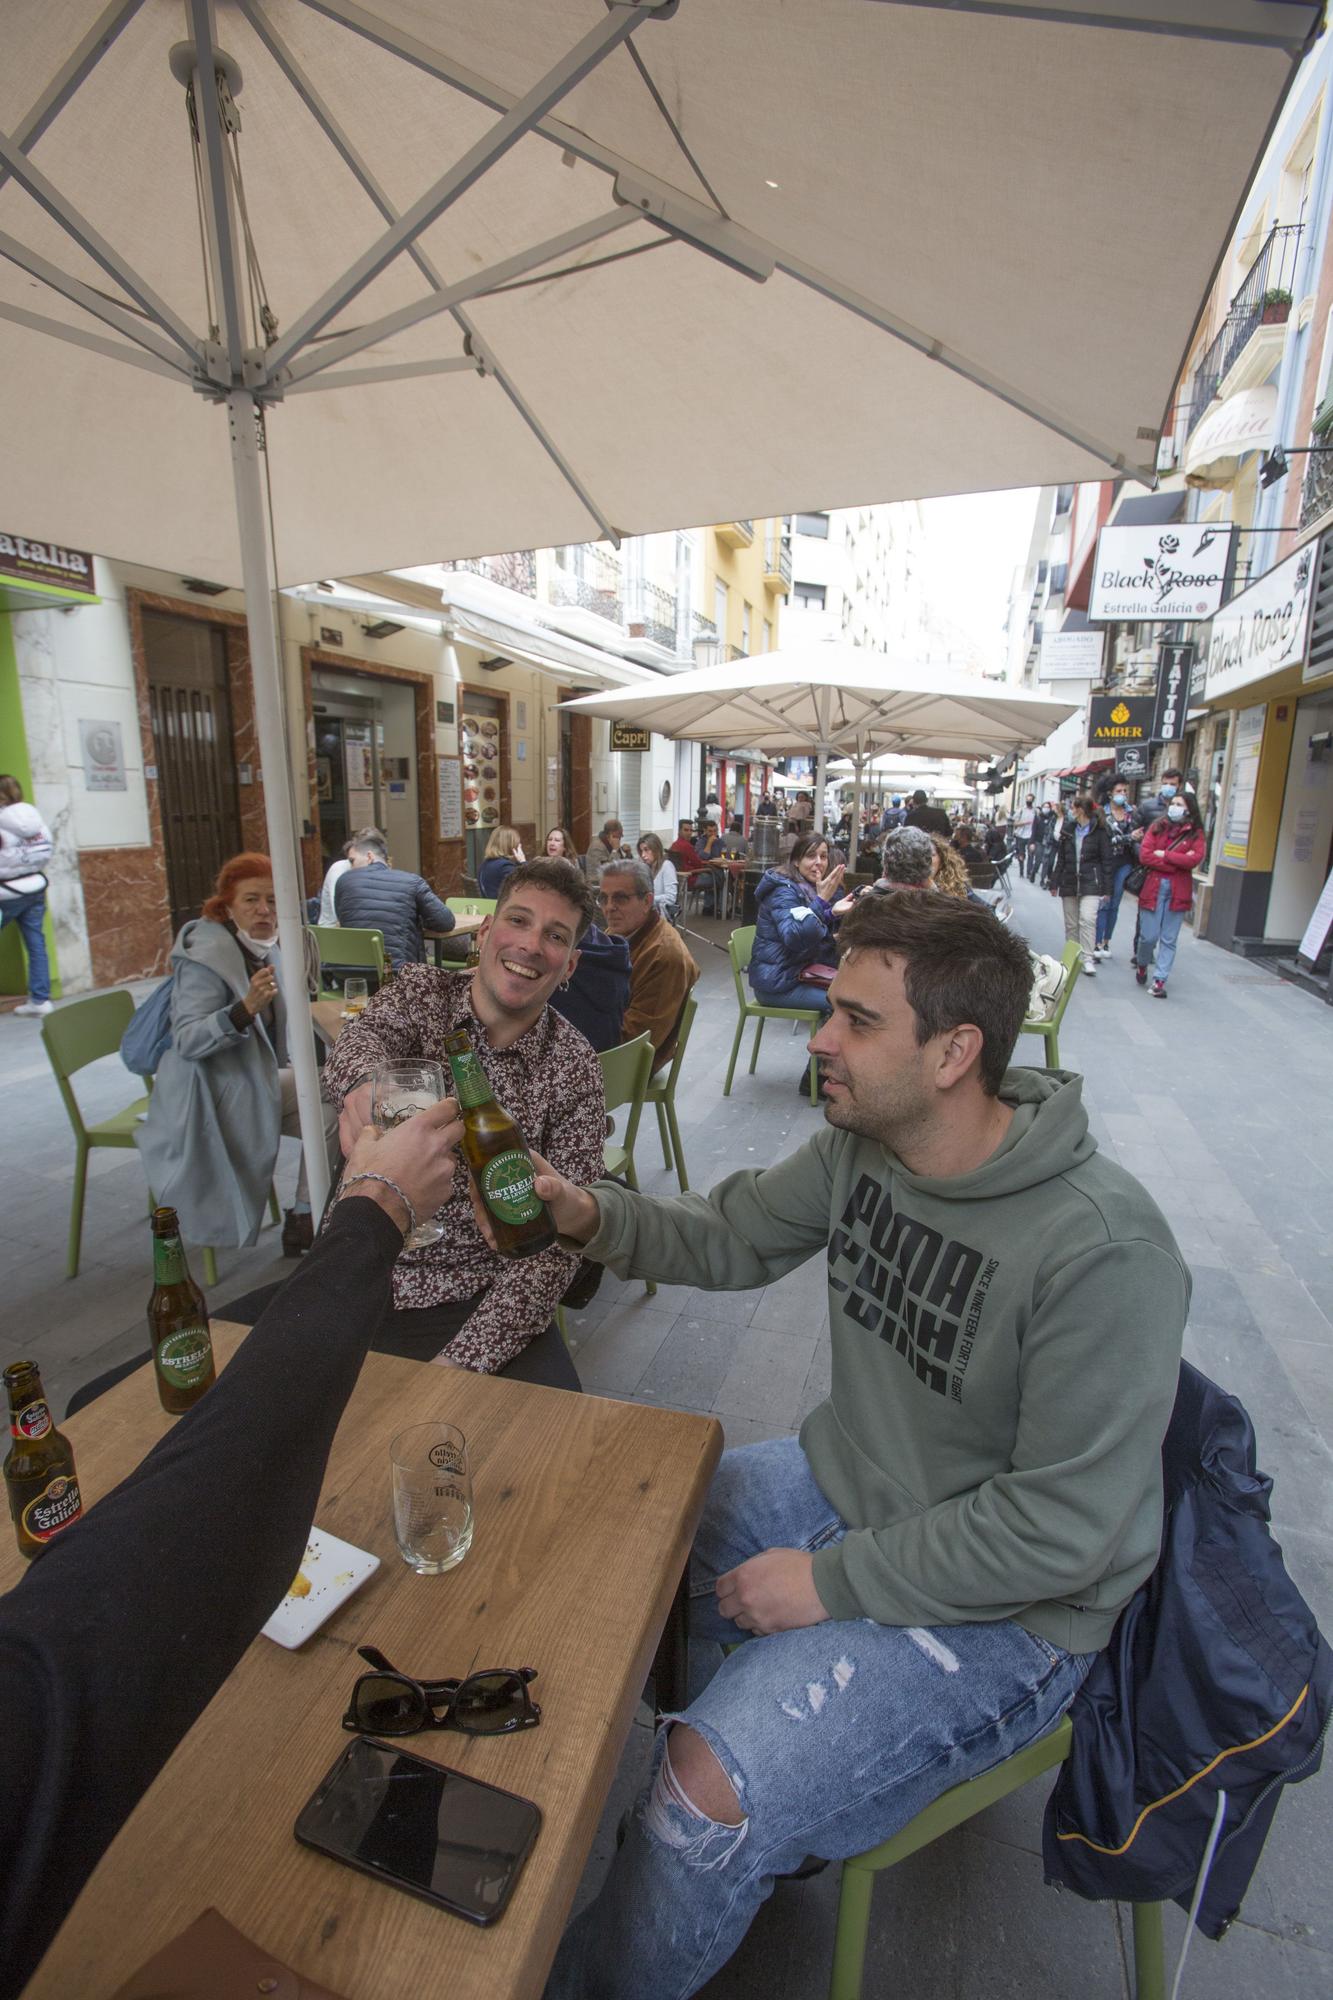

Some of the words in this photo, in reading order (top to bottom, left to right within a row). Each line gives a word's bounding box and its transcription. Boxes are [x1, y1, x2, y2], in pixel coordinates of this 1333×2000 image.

[1101, 570, 1154, 590] Black
[1168, 570, 1218, 588] Rose
[1104, 602, 1148, 614] Estrella
[1151, 602, 1192, 614] Galicia
[1161, 649, 1184, 739] TATTOO
[614, 730, 647, 747] Capri
[1094, 727, 1142, 737] AMBER
[840, 1172, 983, 1319] PUMA
[978, 1258, 1000, 1290] SINCE
[964, 1288, 986, 1340] NINETEEN
[954, 1338, 973, 1376] FORTY
[951, 1374, 963, 1405] EIGHT
[34, 1487, 79, 1520] Estrella
[38, 1499, 80, 1530] Galicia
